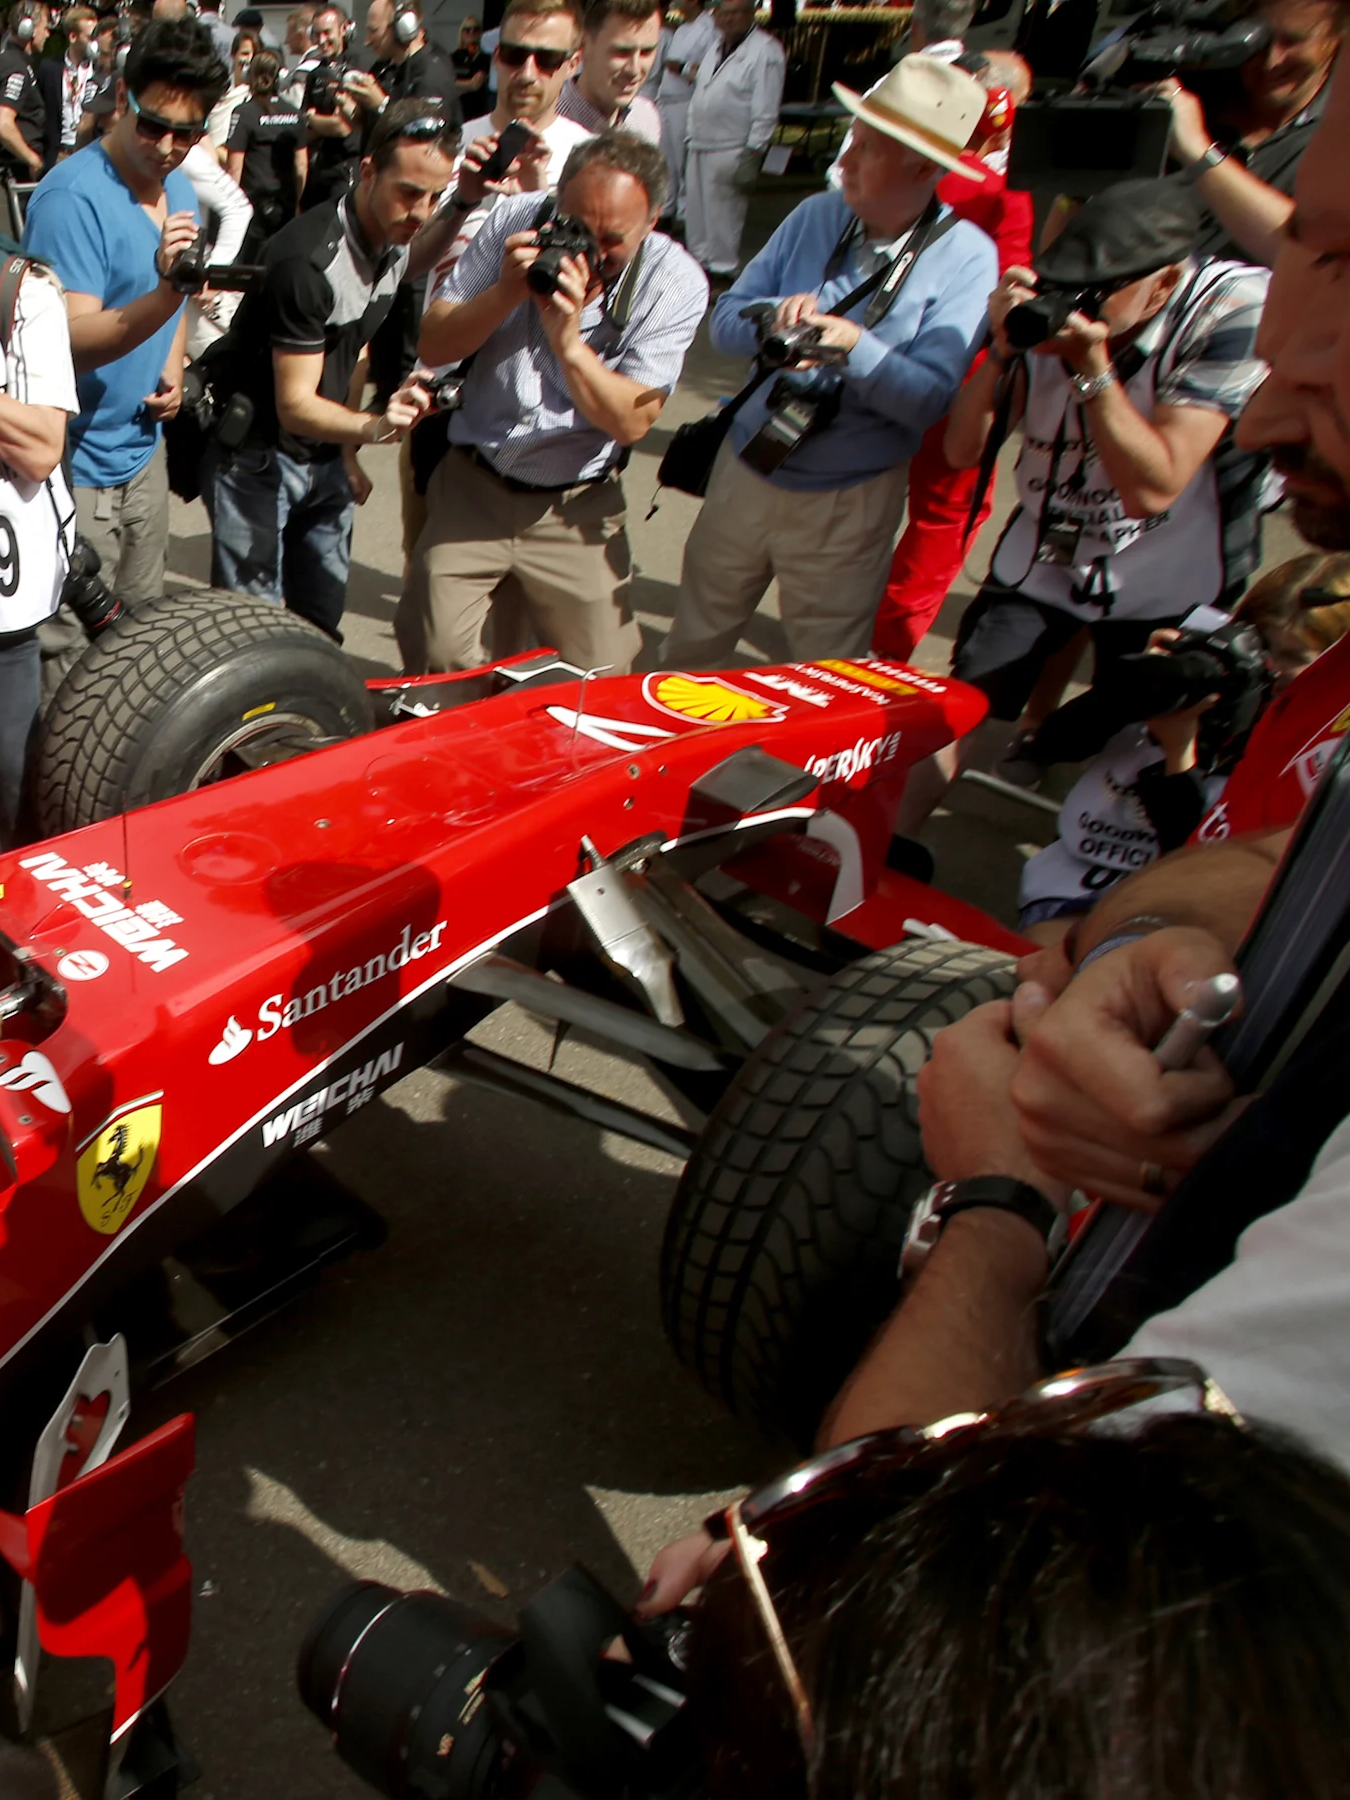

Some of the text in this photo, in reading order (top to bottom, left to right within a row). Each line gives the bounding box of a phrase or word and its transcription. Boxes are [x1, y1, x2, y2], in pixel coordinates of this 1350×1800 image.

[18, 851, 190, 974] WEICHAI
[256, 920, 448, 1042] Santander
[261, 1041, 405, 1149] WEICHAI
